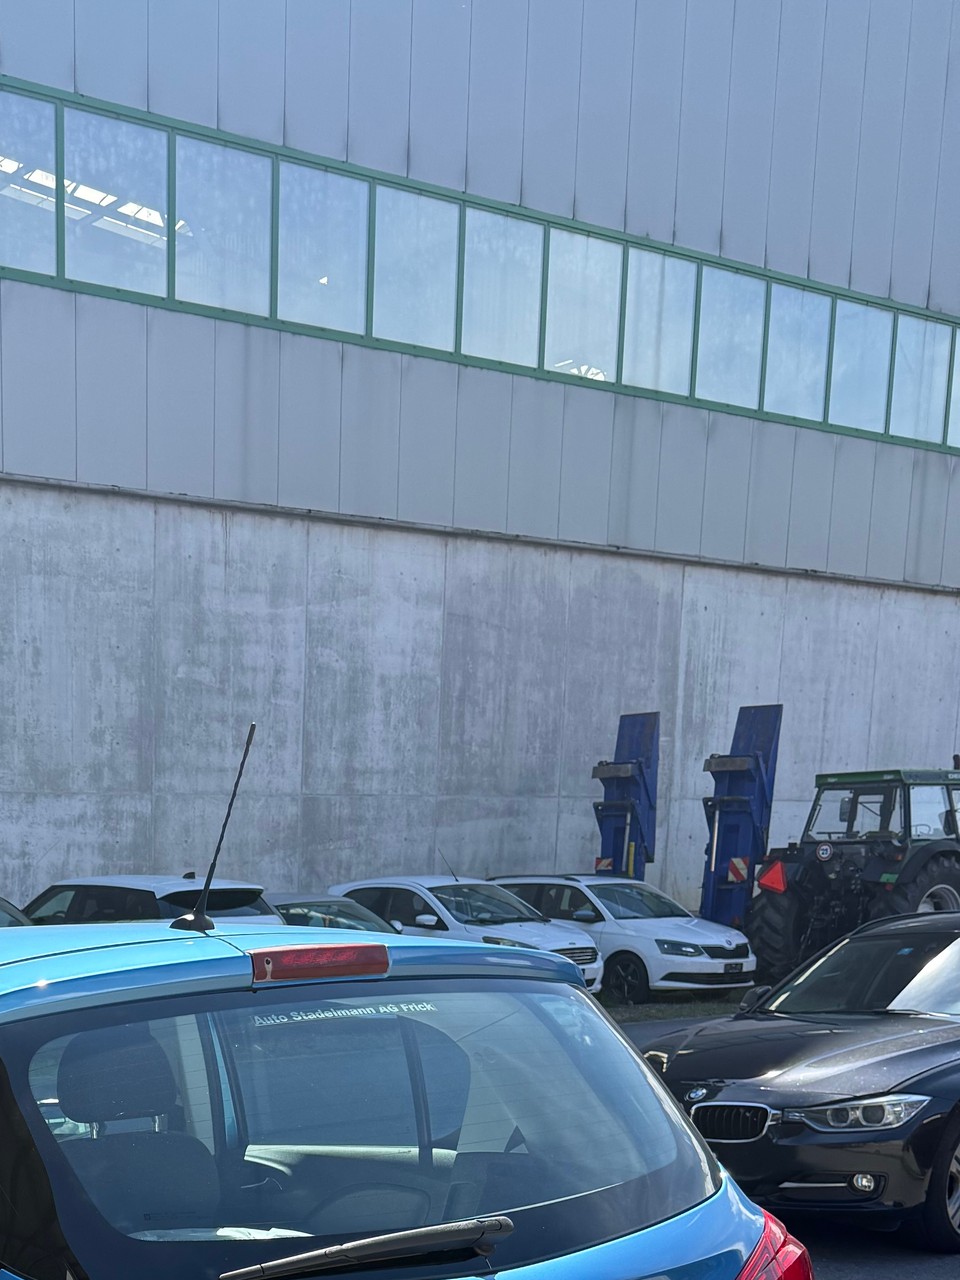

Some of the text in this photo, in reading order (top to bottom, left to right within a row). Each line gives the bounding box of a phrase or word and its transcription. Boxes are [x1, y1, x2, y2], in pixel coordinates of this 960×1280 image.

[254, 1002, 435, 1025] Auto Stadelmann AG Frick
